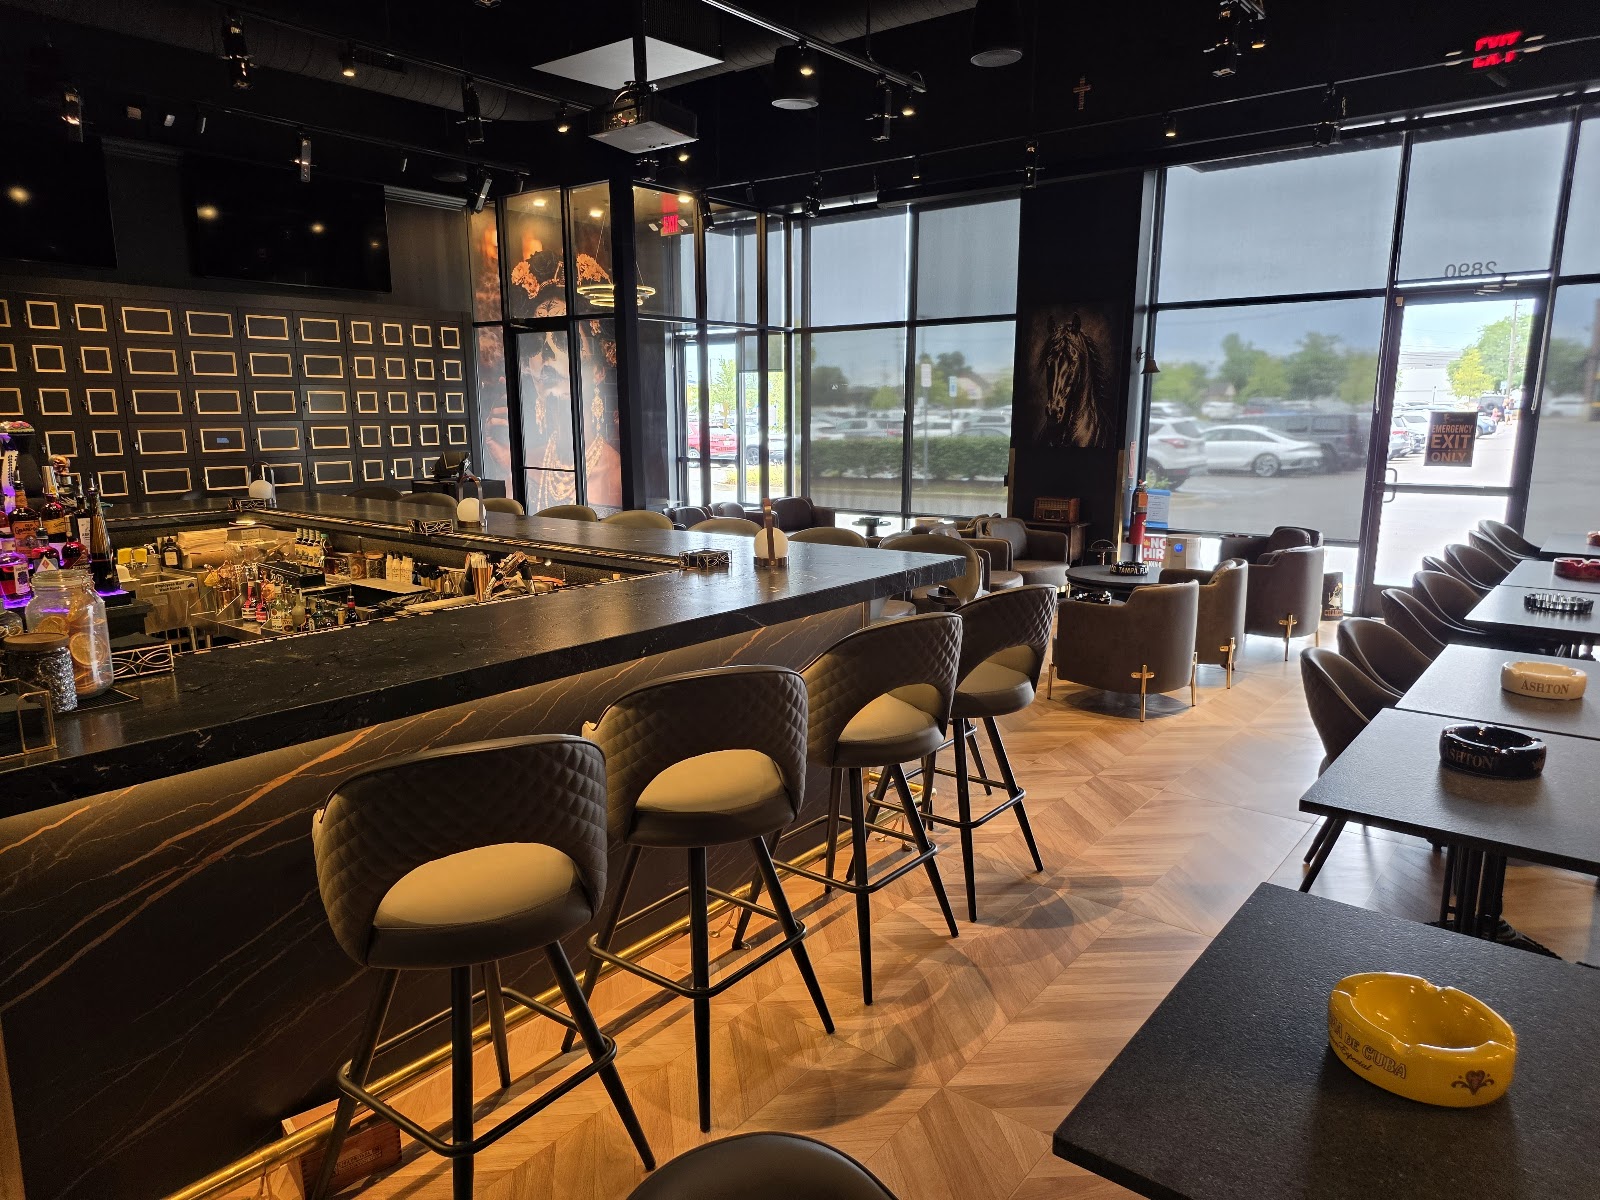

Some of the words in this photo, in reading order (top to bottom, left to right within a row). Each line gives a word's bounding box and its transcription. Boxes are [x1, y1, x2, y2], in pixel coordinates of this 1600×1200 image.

[664, 214, 679, 234] EXIT
[1431, 424, 1474, 433] EMERGENCY
[1430, 434, 1471, 449] EXIT
[1431, 452, 1467, 463] ONLY
[1150, 537, 1167, 549] NO
[1143, 547, 1165, 560] HIR
[1521, 680, 1570, 695] ASHTON
[1344, 1032, 1360, 1052] DE
[1361, 1044, 1407, 1079] CUBA
